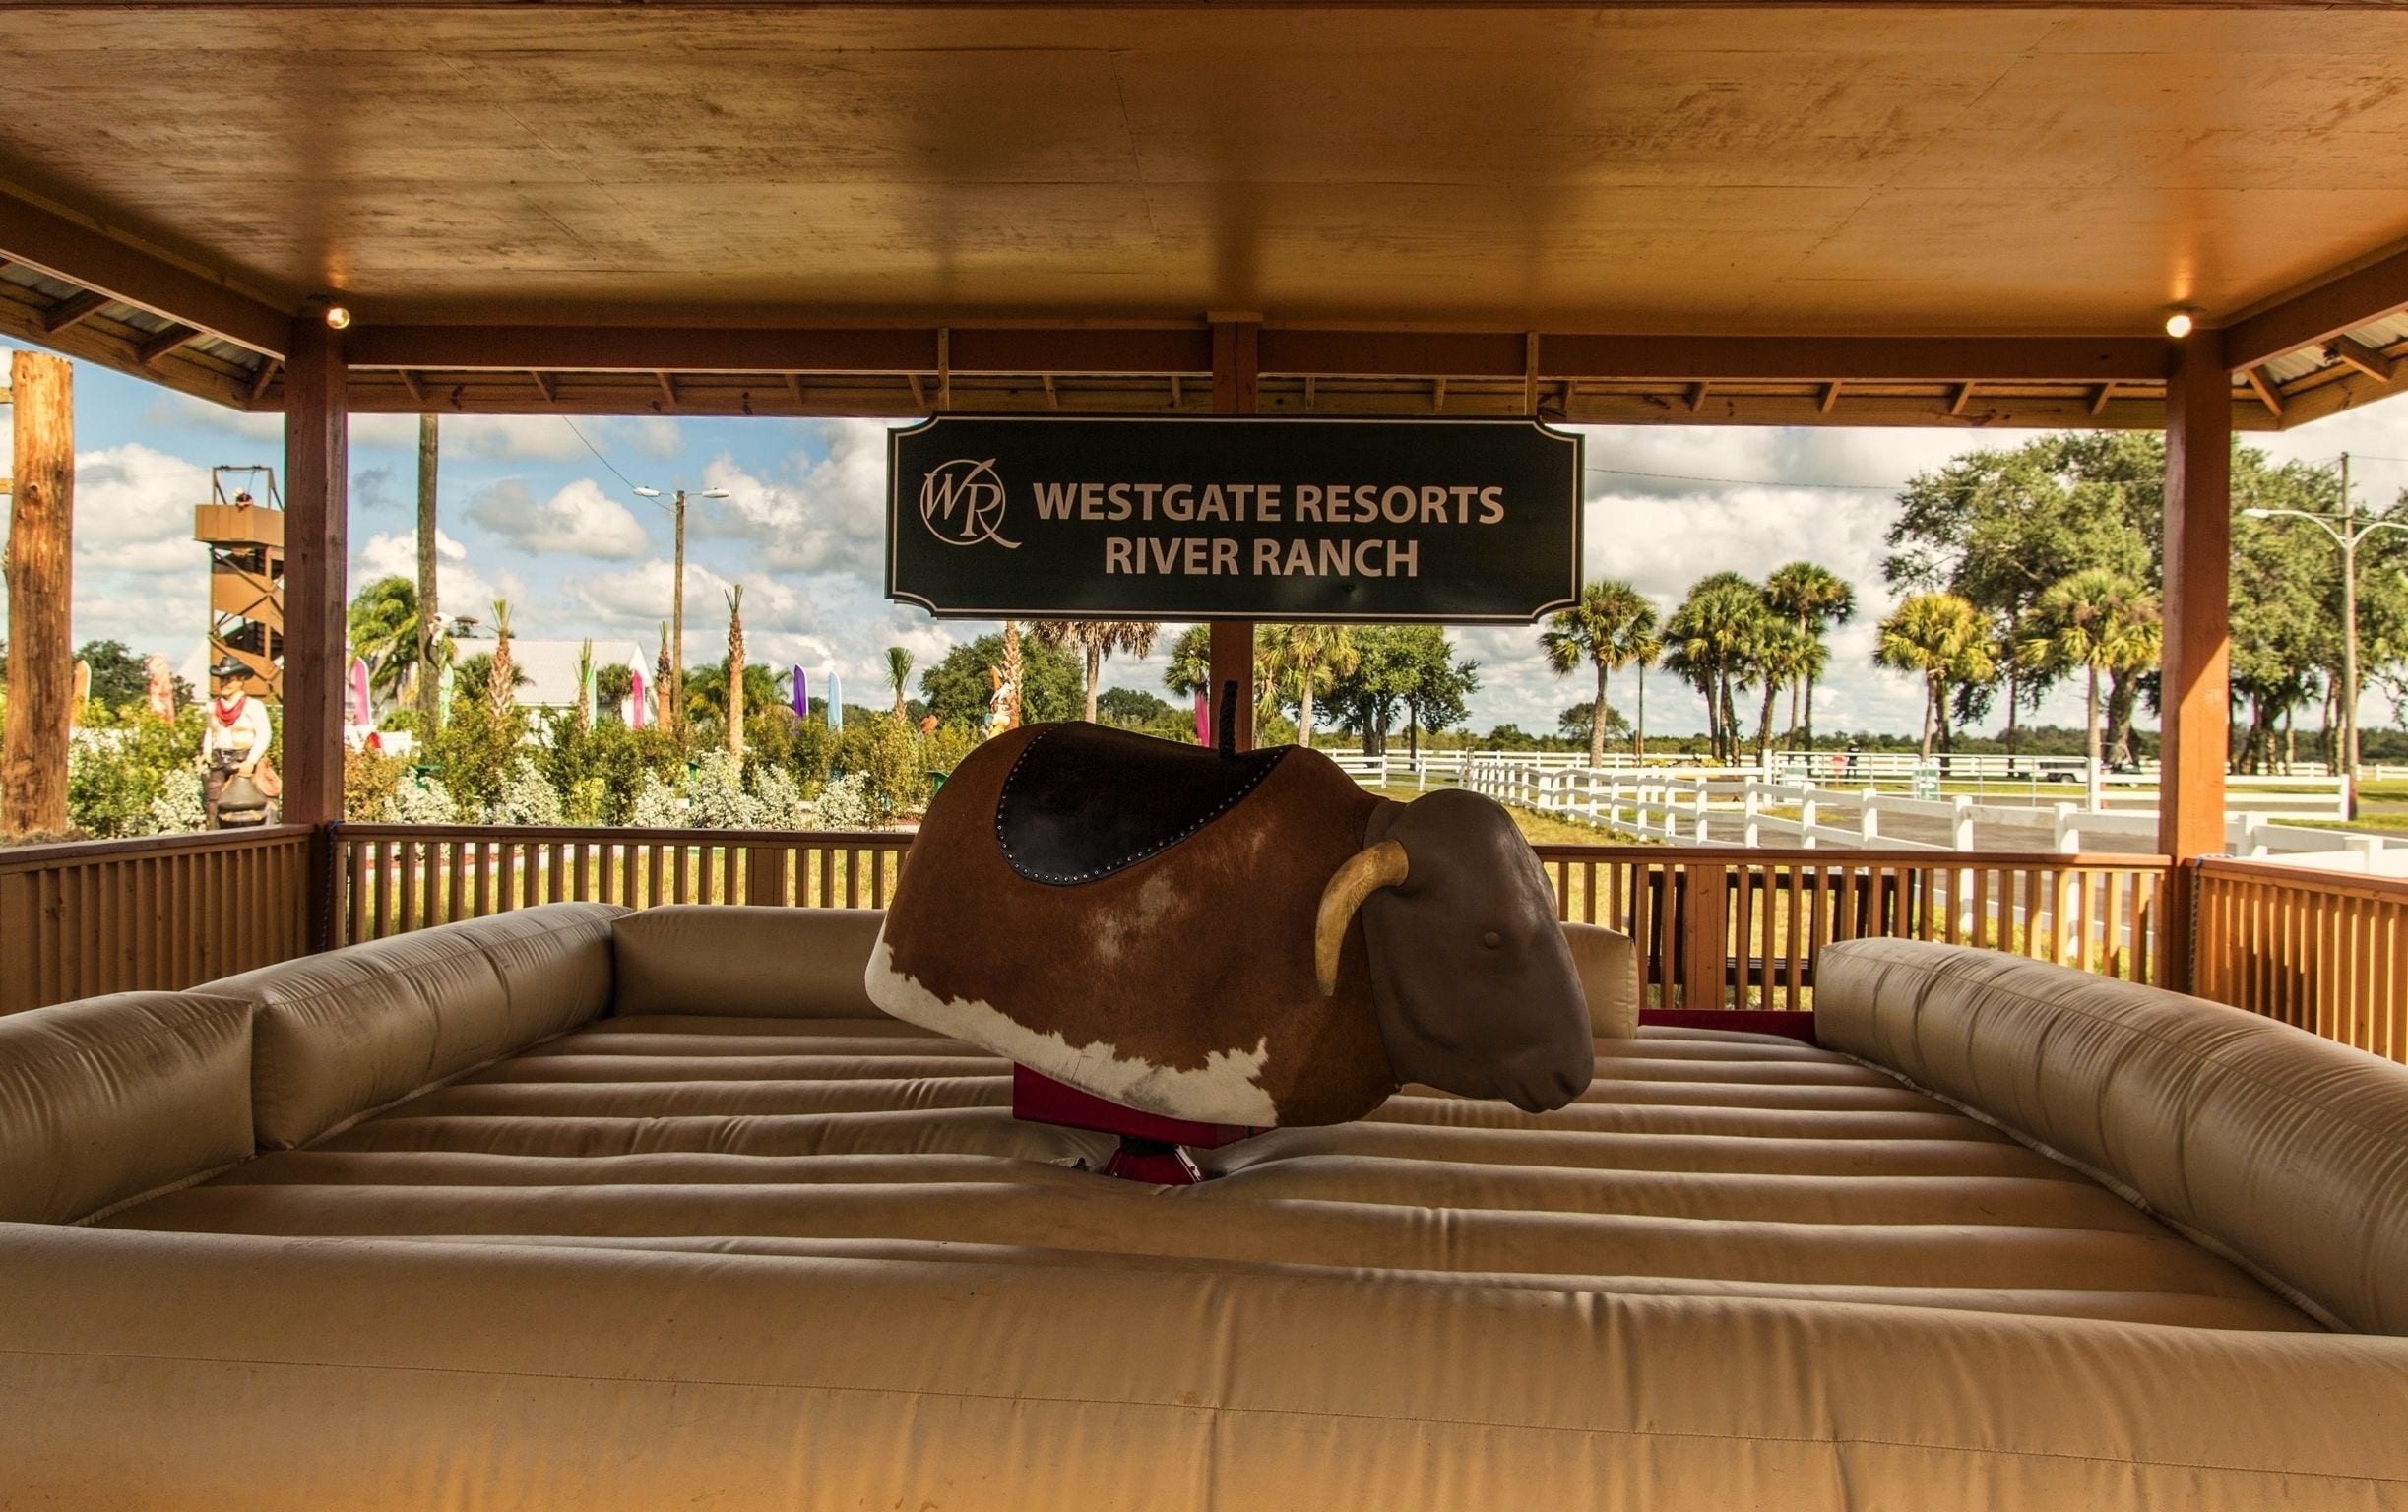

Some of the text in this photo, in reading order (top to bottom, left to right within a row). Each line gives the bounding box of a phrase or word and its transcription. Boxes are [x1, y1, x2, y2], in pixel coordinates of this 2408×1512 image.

[1033, 482, 1505, 525] WESTGATE RESORTS
[1106, 536, 1418, 578] RIVER RANCH
